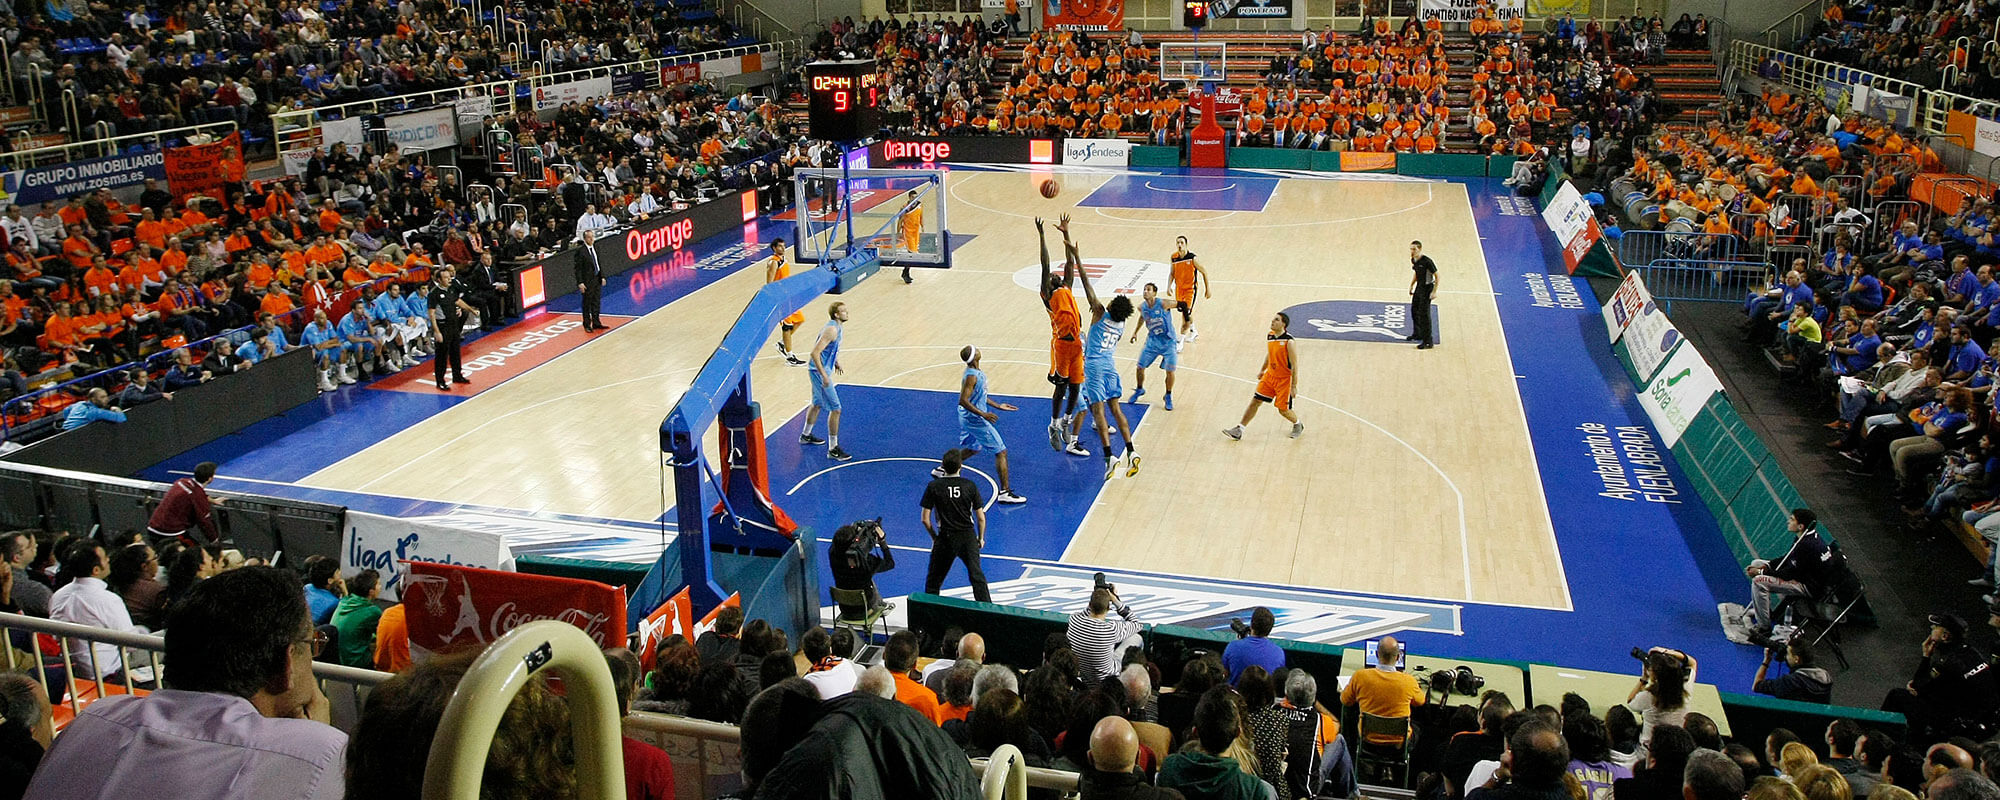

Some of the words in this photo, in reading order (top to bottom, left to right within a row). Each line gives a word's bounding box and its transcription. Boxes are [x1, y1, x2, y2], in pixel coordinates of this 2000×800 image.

[814, 76, 851, 90] 02:44
[834, 91, 848, 111] 9
[884, 139, 951, 163] Orange
[1067, 144, 1087, 160] liga
[1091, 144, 1124, 158] endesa
[25, 165, 77, 188] GRUPO
[79, 151, 165, 178] INMOBILIARIO
[54, 170, 145, 195] www.zosma.es
[626, 217, 694, 261] Orange
[1101, 331, 1120, 349] 35
[1576, 422, 1609, 434] de
[1581, 435, 1642, 501] Ayuntamiento
[1614, 426, 1683, 504] FUENLABRADA
[947, 486, 961, 498] 15
[535, 650, 545, 664] 3
[1574, 768, 1614, 785] GASOL
